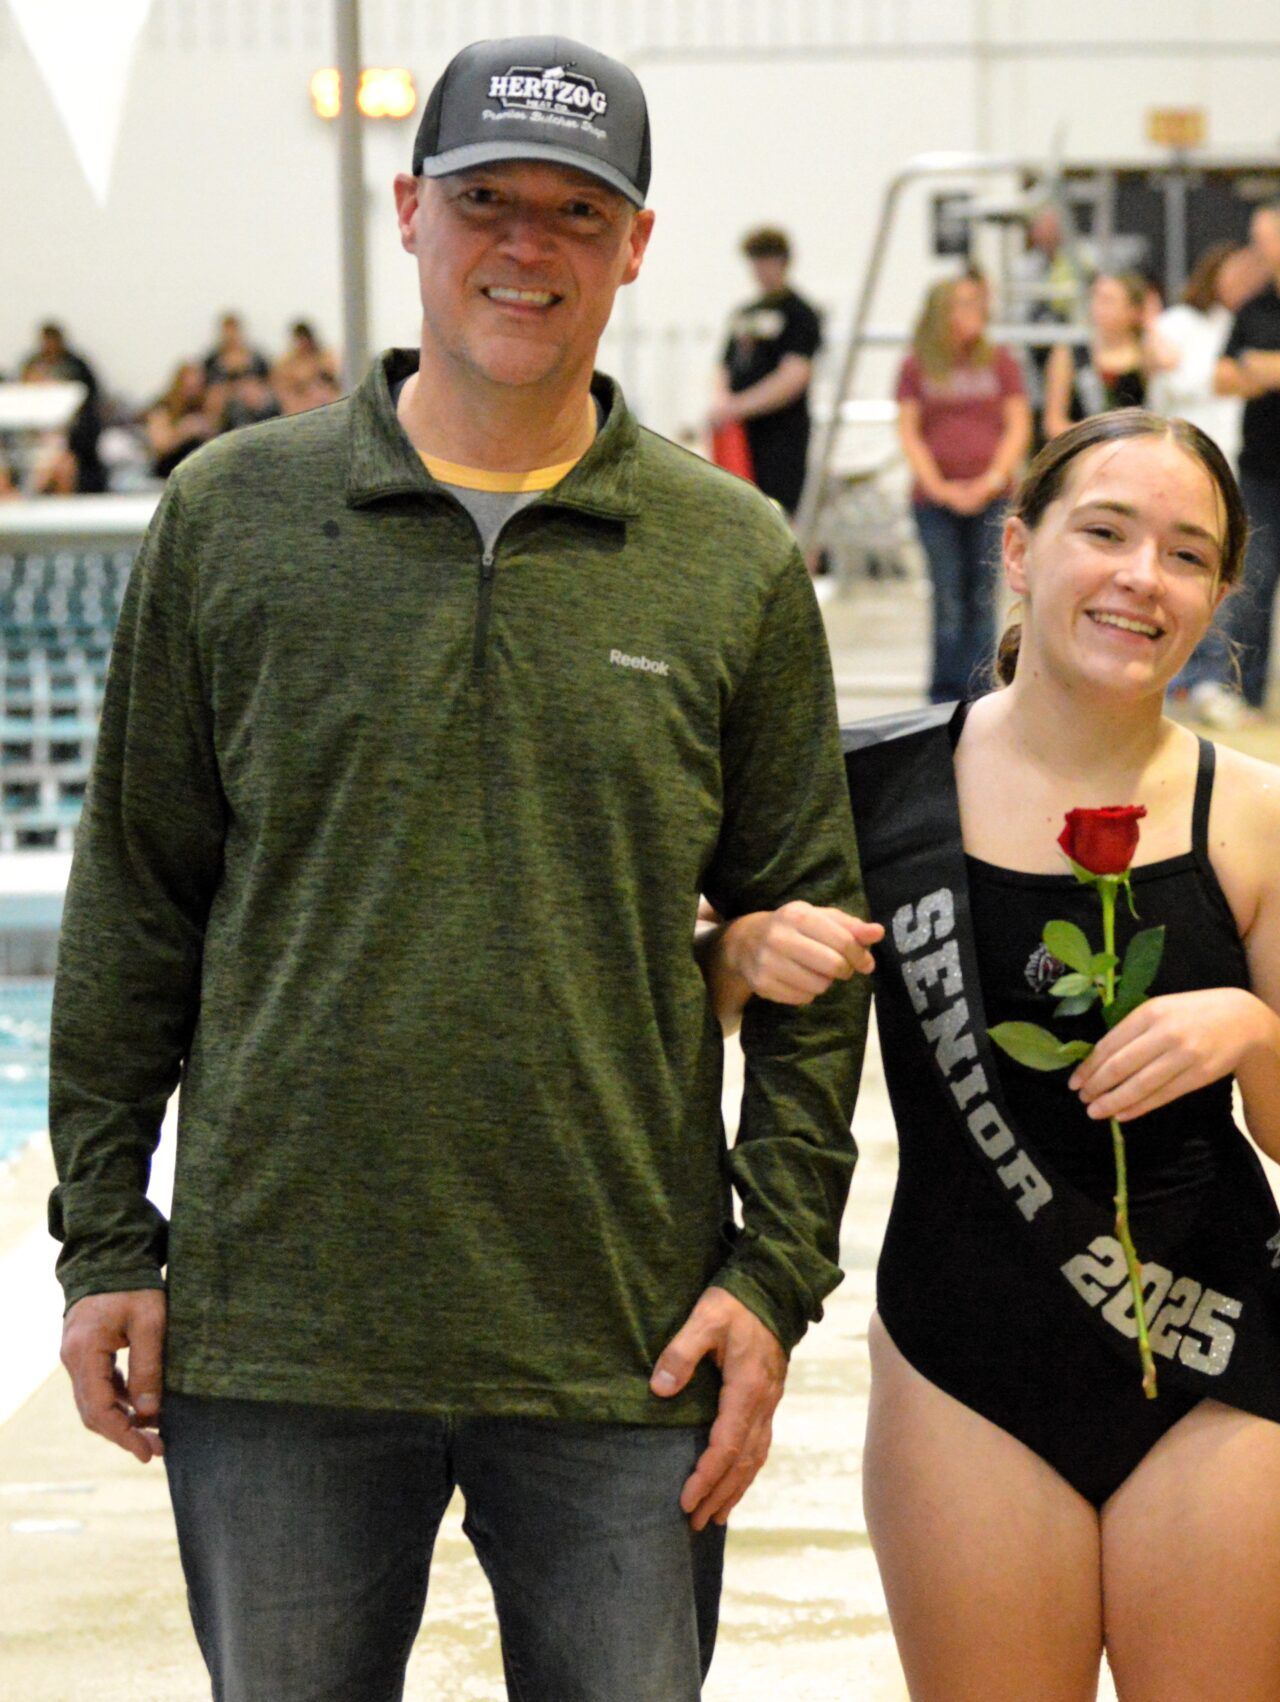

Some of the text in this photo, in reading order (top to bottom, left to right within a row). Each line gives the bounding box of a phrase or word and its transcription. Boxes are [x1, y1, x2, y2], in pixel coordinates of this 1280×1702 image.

[488, 76, 607, 115] HERTZOG
[610, 649, 669, 677] Reebok
[892, 888, 1243, 1377] SENIOR 2025
